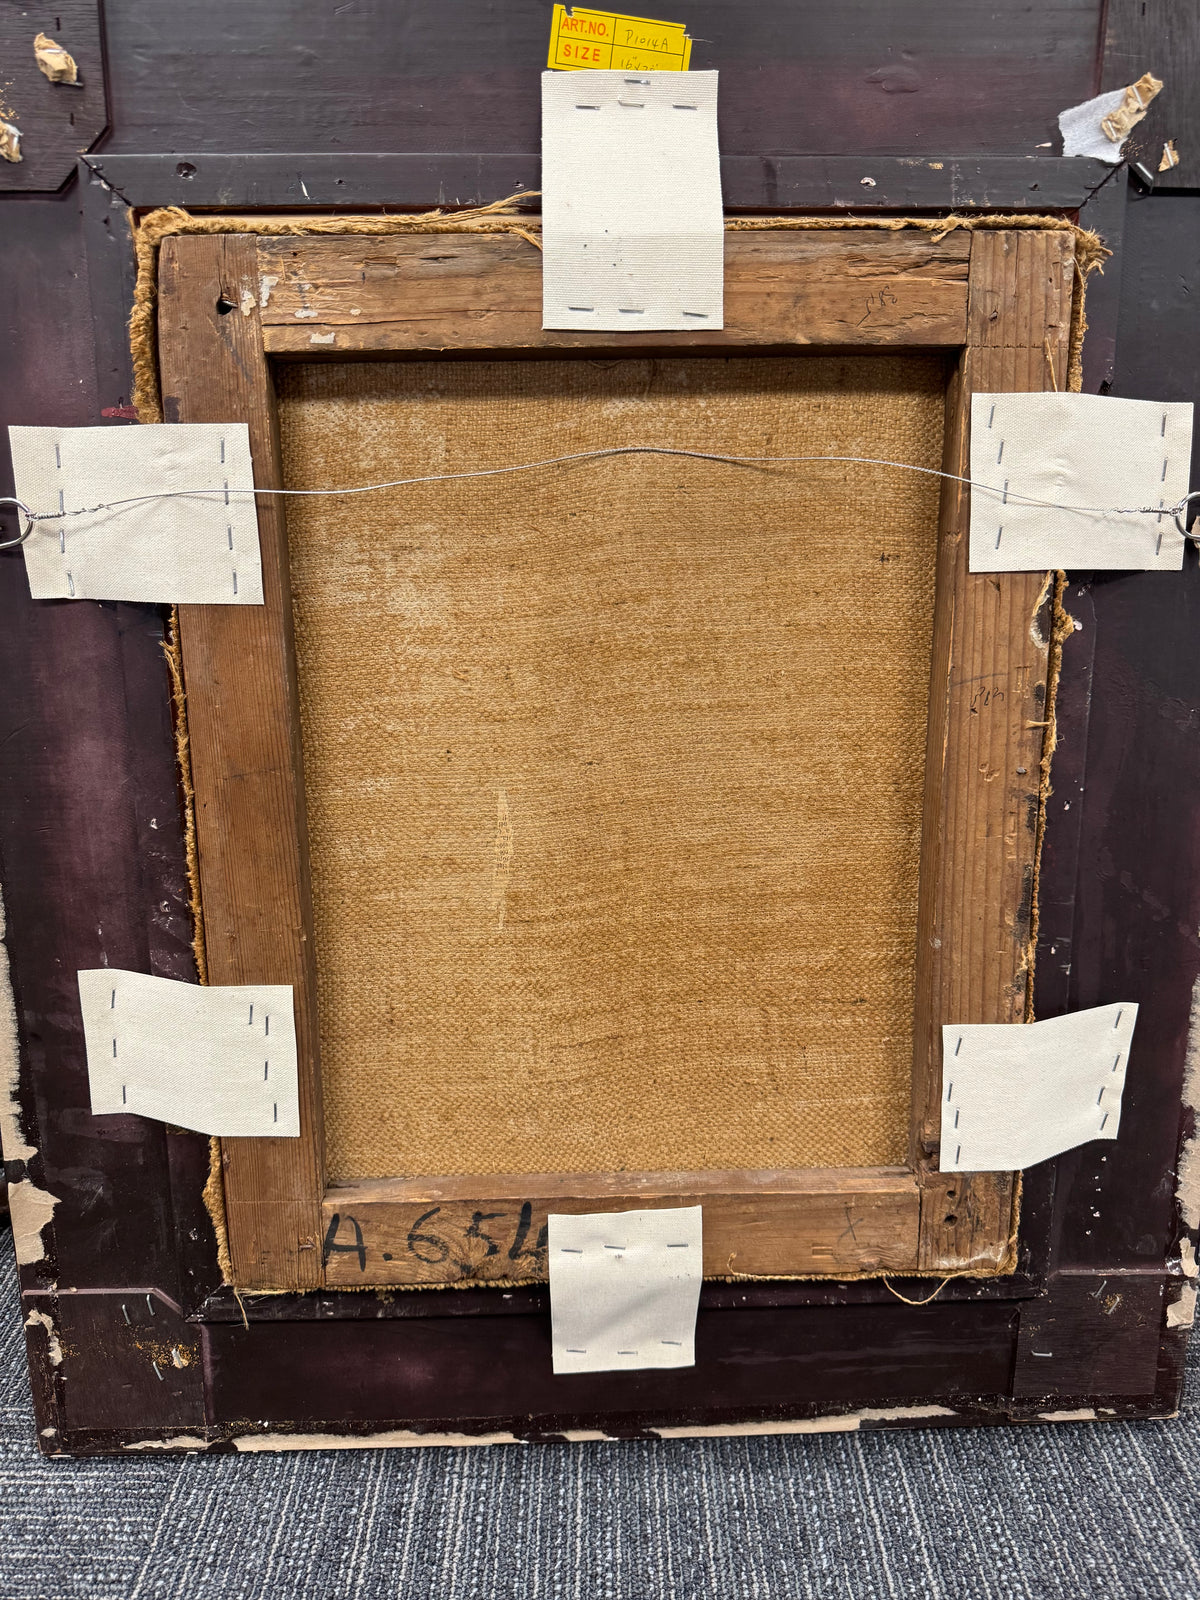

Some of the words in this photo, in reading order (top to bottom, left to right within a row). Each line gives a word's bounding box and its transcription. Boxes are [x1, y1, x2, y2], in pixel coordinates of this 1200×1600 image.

[561, 17, 609, 37] ART.NO.
[625, 29, 669, 50] P1014A
[563, 44, 601, 62] SIZE
